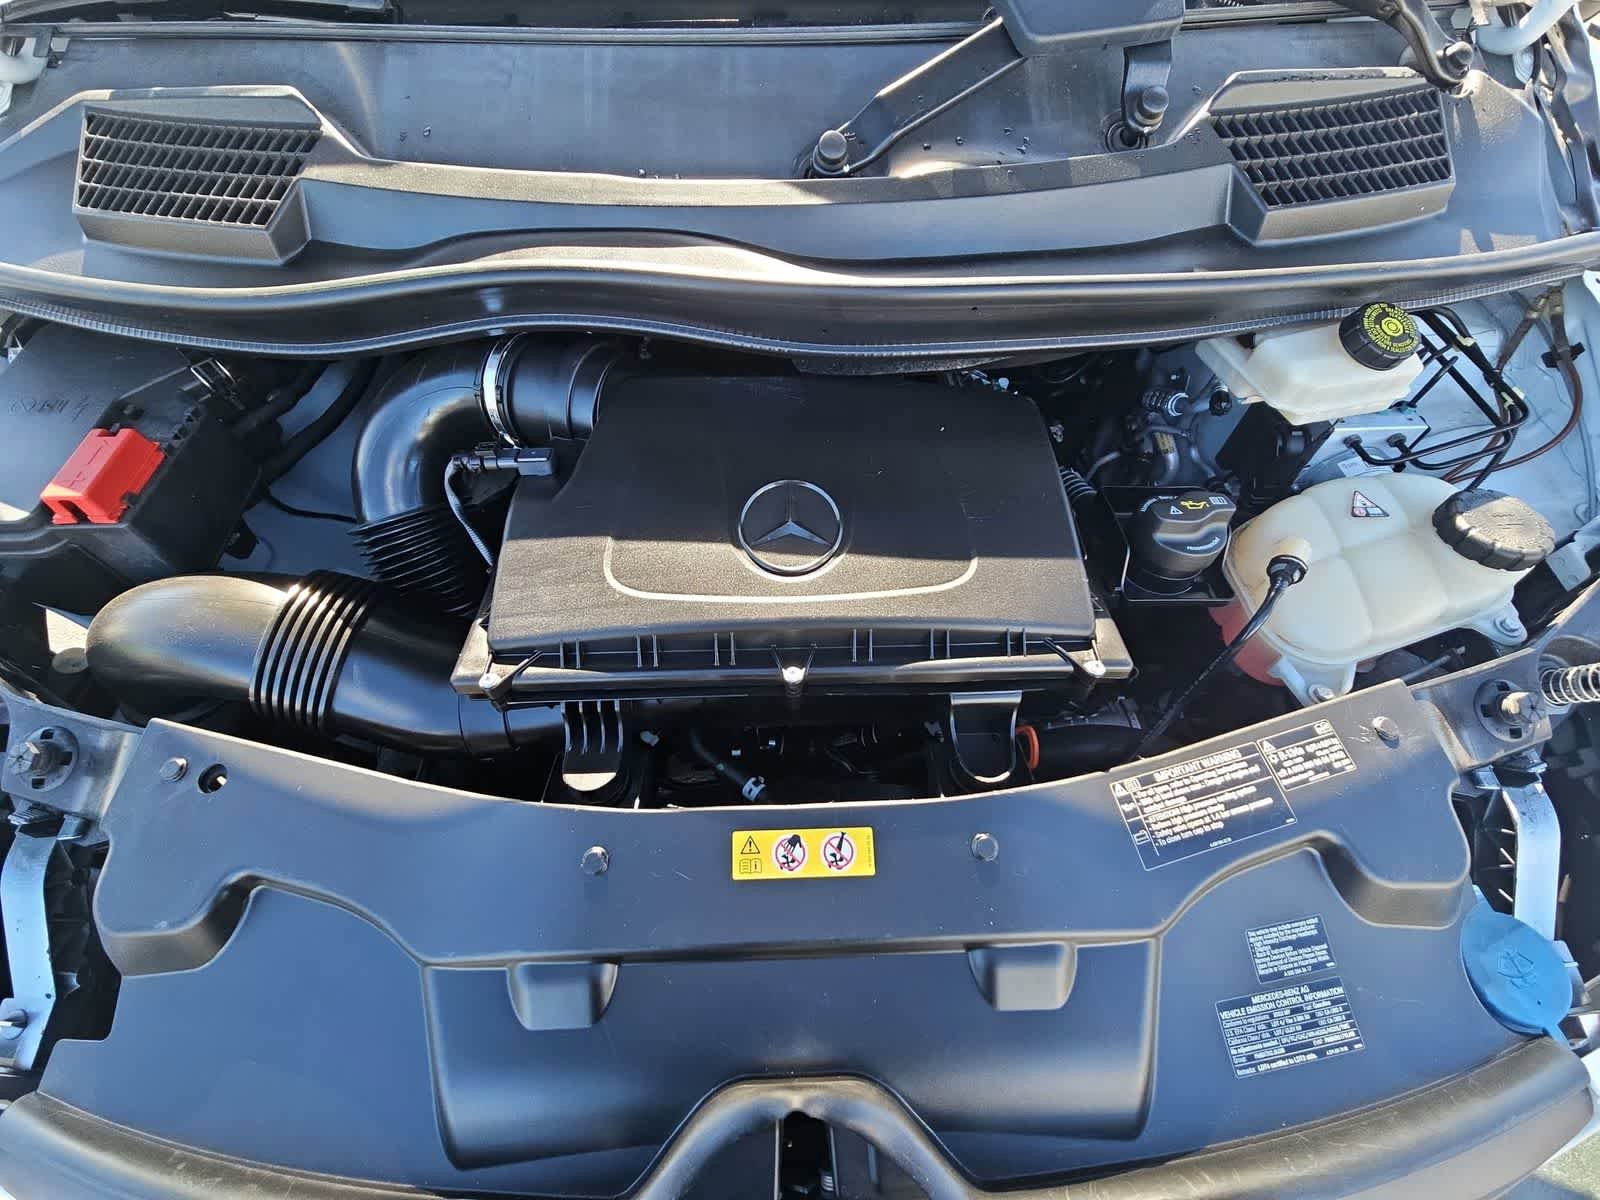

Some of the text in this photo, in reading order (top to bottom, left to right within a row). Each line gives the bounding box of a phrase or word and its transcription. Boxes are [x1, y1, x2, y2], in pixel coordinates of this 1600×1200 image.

[1153, 749, 1242, 782] IMPORTANT WARNING
[1166, 834, 1181, 843] close
[1181, 830, 1193, 839] turn
[1192, 827, 1205, 836] cap
[1220, 987, 1344, 1020] VEHICLE EMISSION CONTROL INFORMATION
[1251, 985, 1310, 1004] MERCEDES-BENZ AG
[1270, 1058, 1289, 1068] certified
